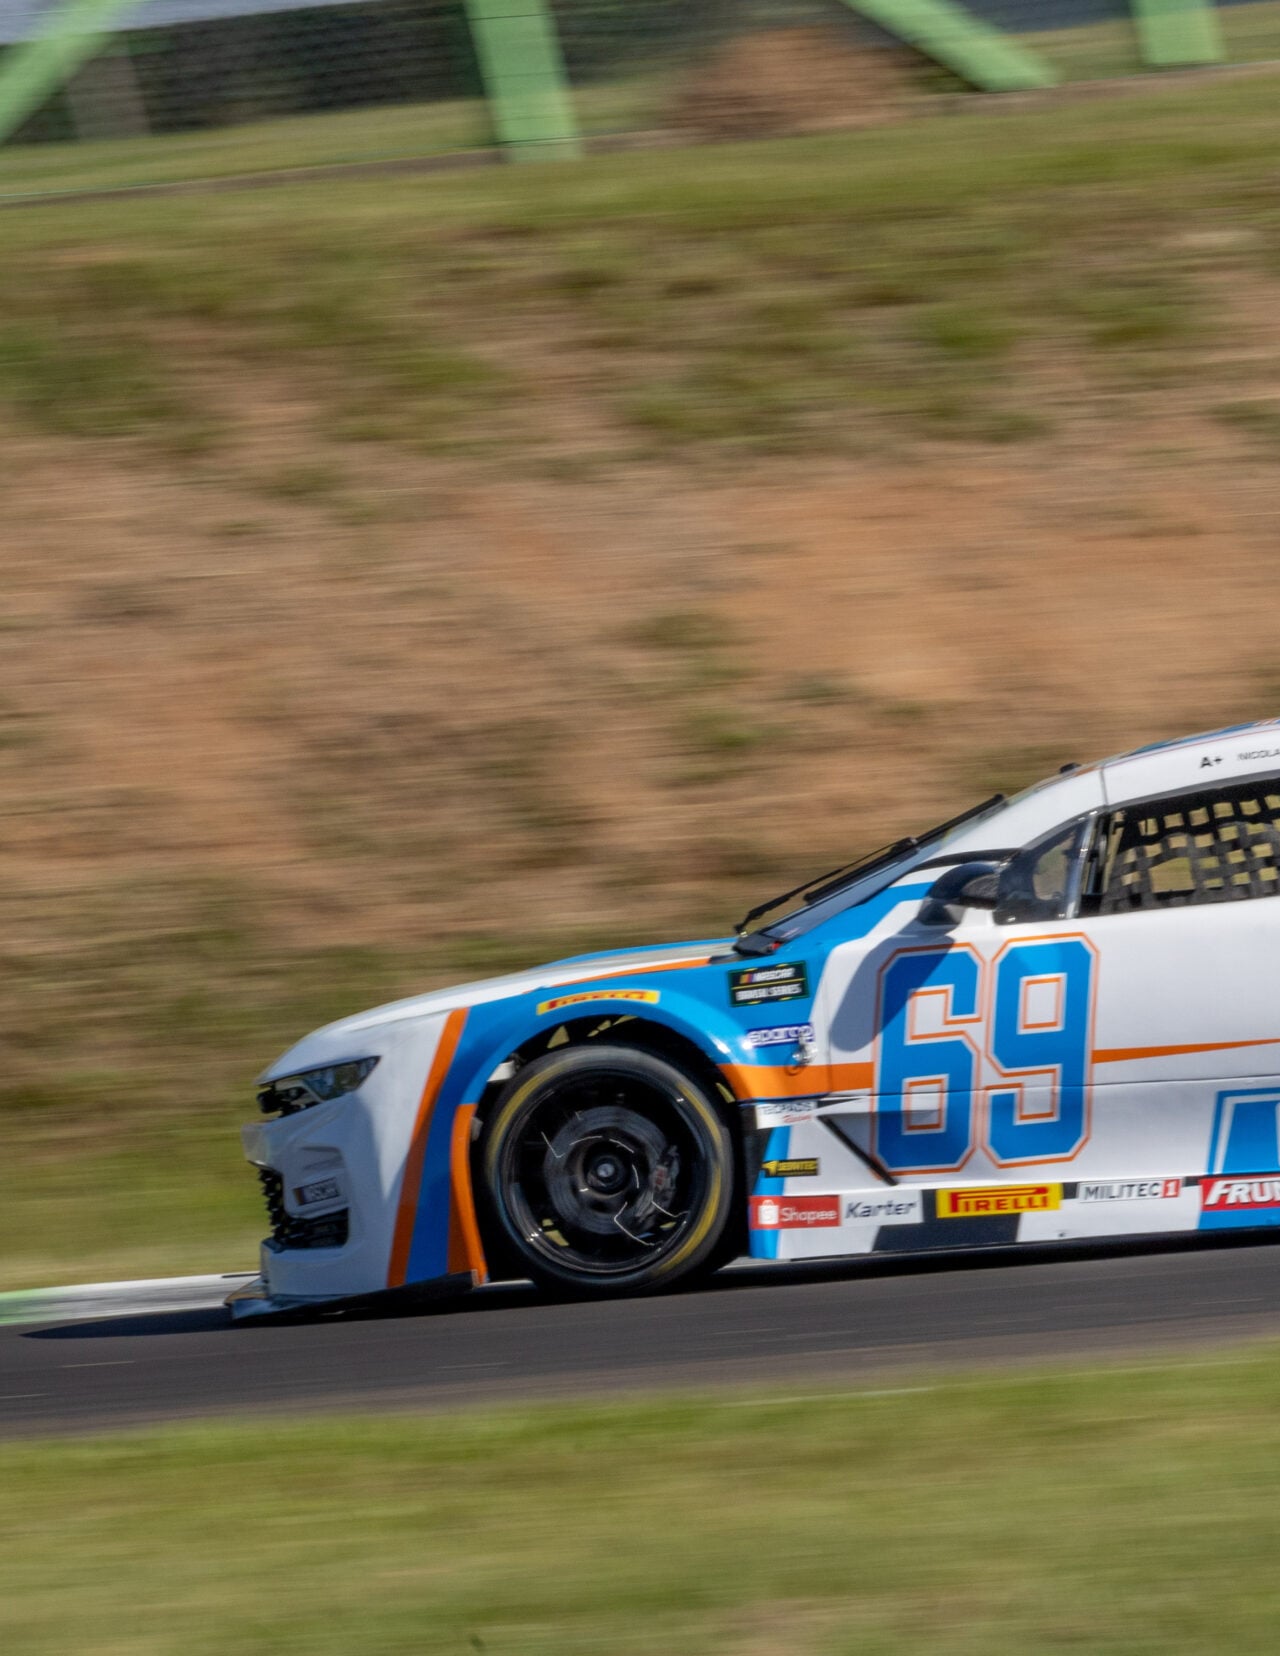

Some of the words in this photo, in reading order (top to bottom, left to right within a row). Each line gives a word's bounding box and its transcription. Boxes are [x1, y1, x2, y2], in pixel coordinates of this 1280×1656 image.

[1199, 756, 1223, 768] A+
[752, 967, 796, 983] NASCAR
[746, 1025, 815, 1047] sparco
[869, 931, 1101, 1180] 69
[949, 1186, 1049, 1213] PIRELLI
[781, 1207, 837, 1225] Shopee
[845, 1200, 917, 1218] Karter
